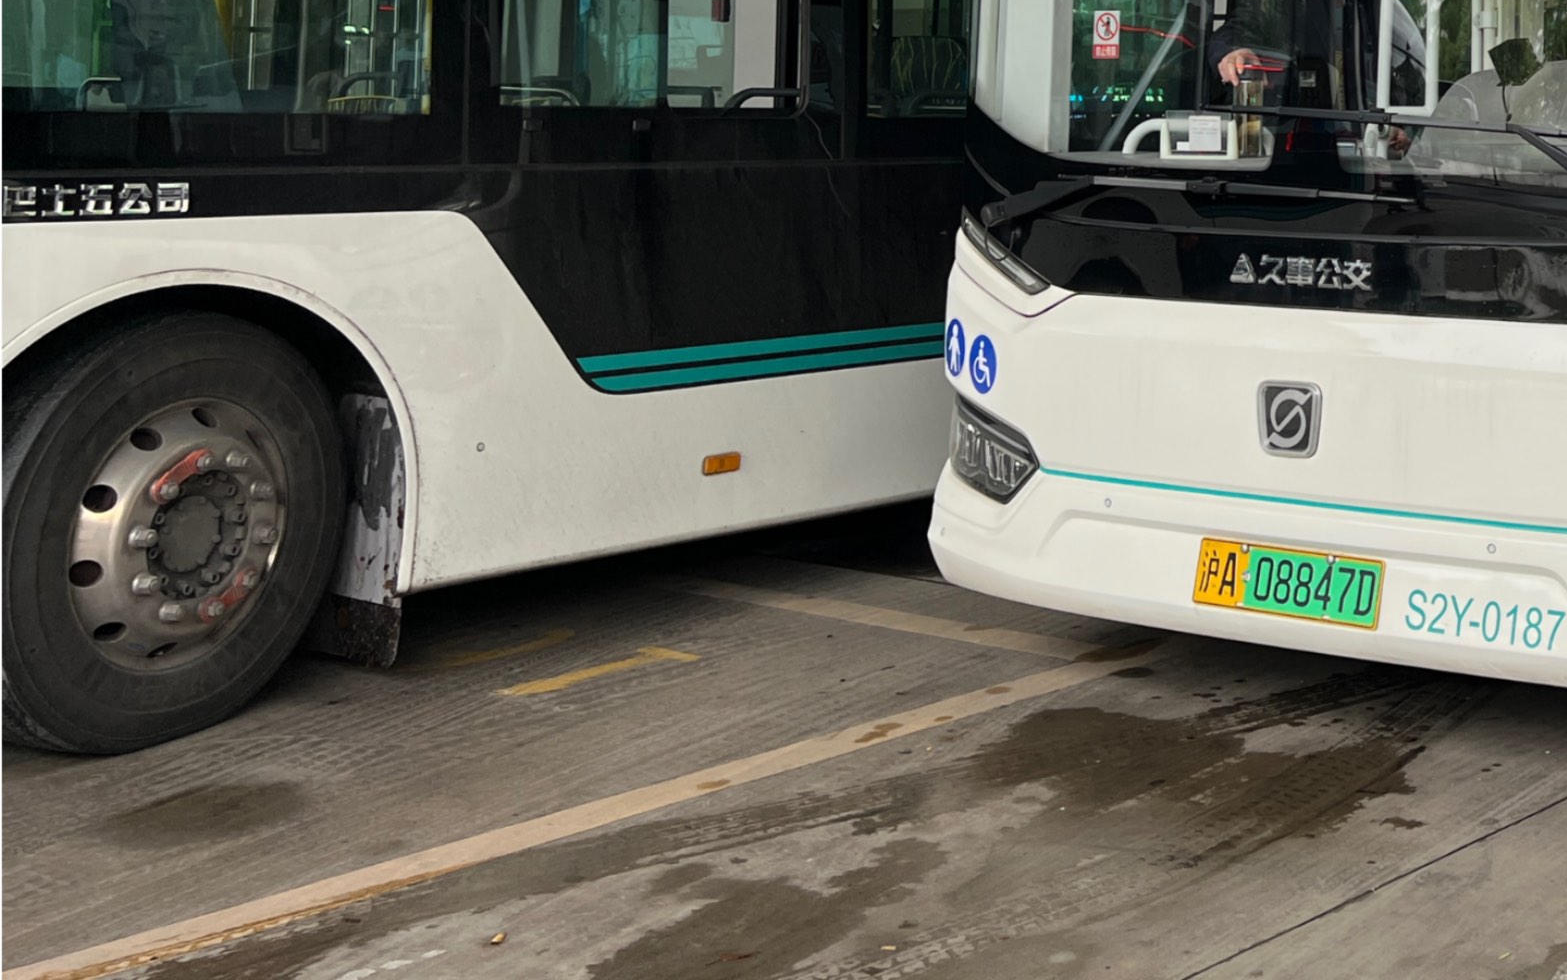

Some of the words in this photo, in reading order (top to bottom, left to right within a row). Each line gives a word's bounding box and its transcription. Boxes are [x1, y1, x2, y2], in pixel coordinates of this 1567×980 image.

[3, 182, 190, 217] 巴士五公司
[1258, 254, 1373, 291] 久事公交
[1405, 588, 1567, 652] S2Y-0187
